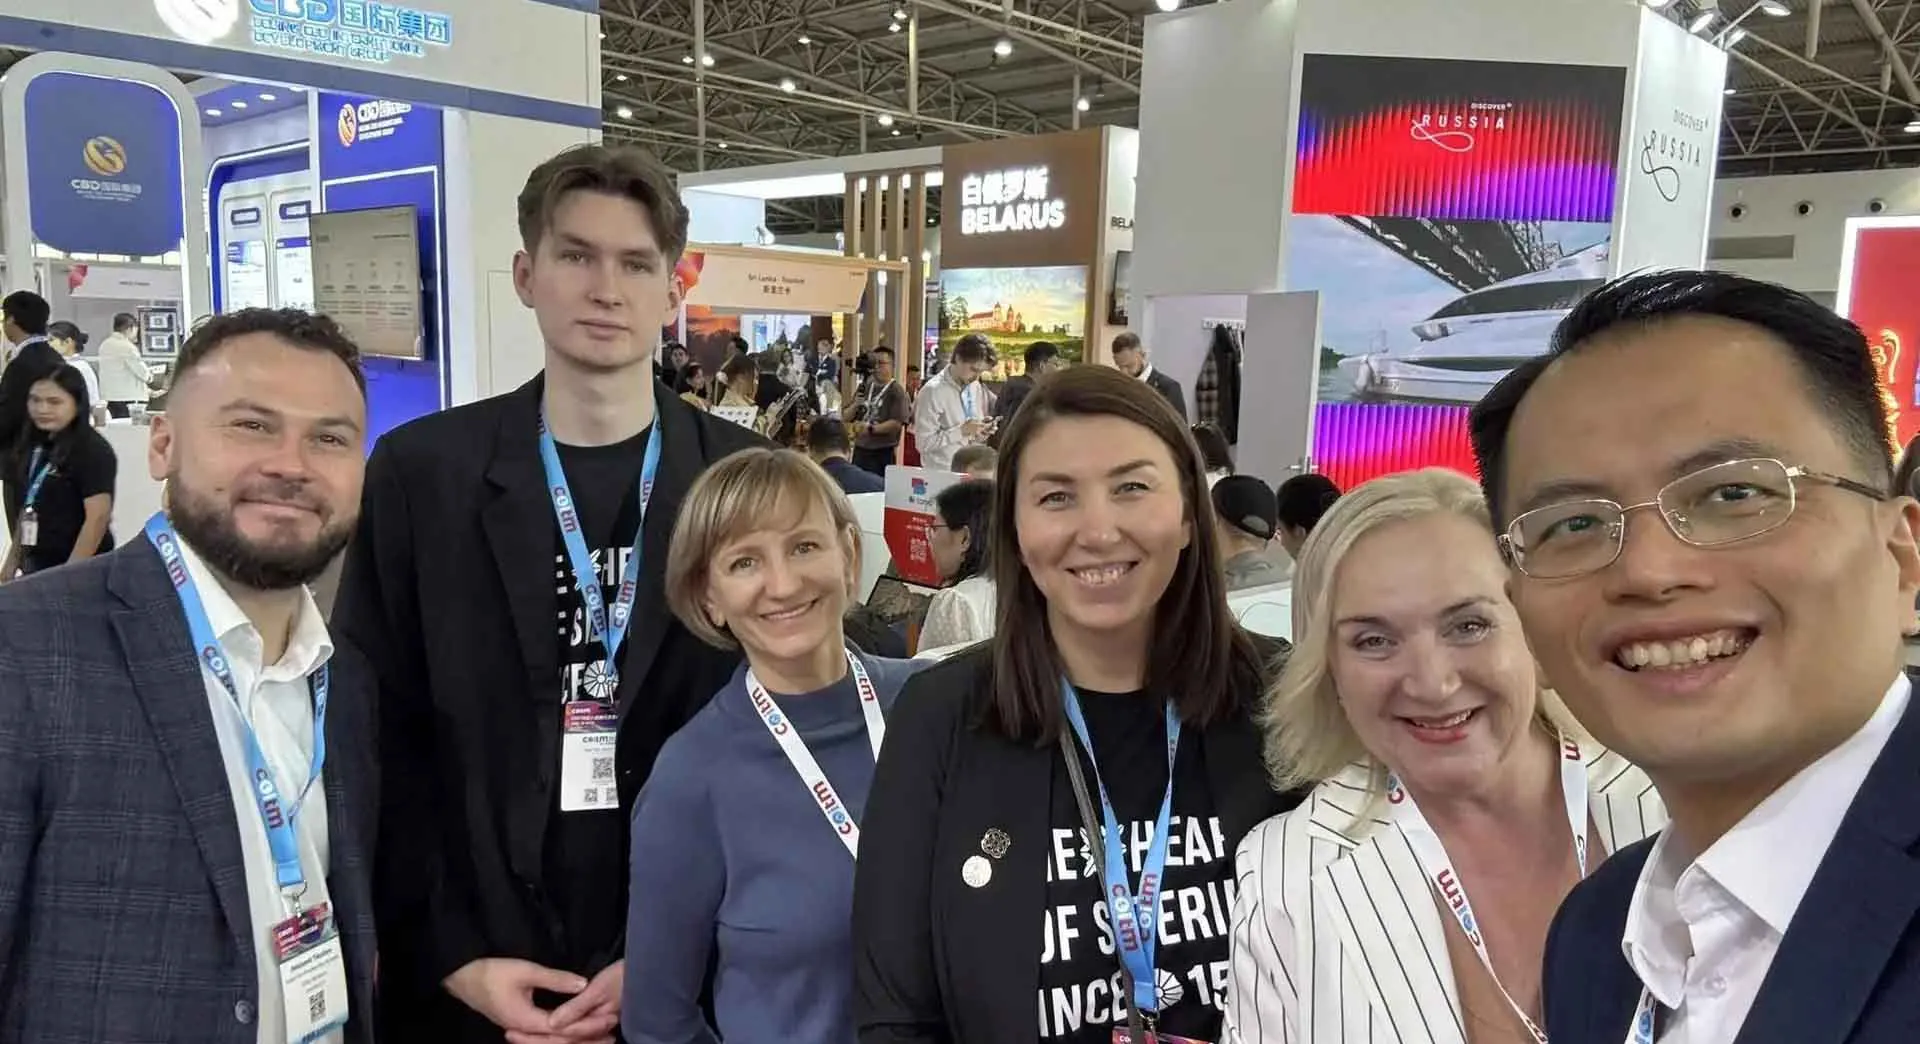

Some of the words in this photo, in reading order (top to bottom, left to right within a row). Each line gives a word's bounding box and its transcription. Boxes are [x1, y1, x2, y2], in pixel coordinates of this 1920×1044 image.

[1470, 102, 1506, 111] DISCOVER
[1421, 113, 1505, 130] RUSSIA
[1649, 128, 1701, 167] RUSSIA
[961, 199, 1067, 236] BELARUS
